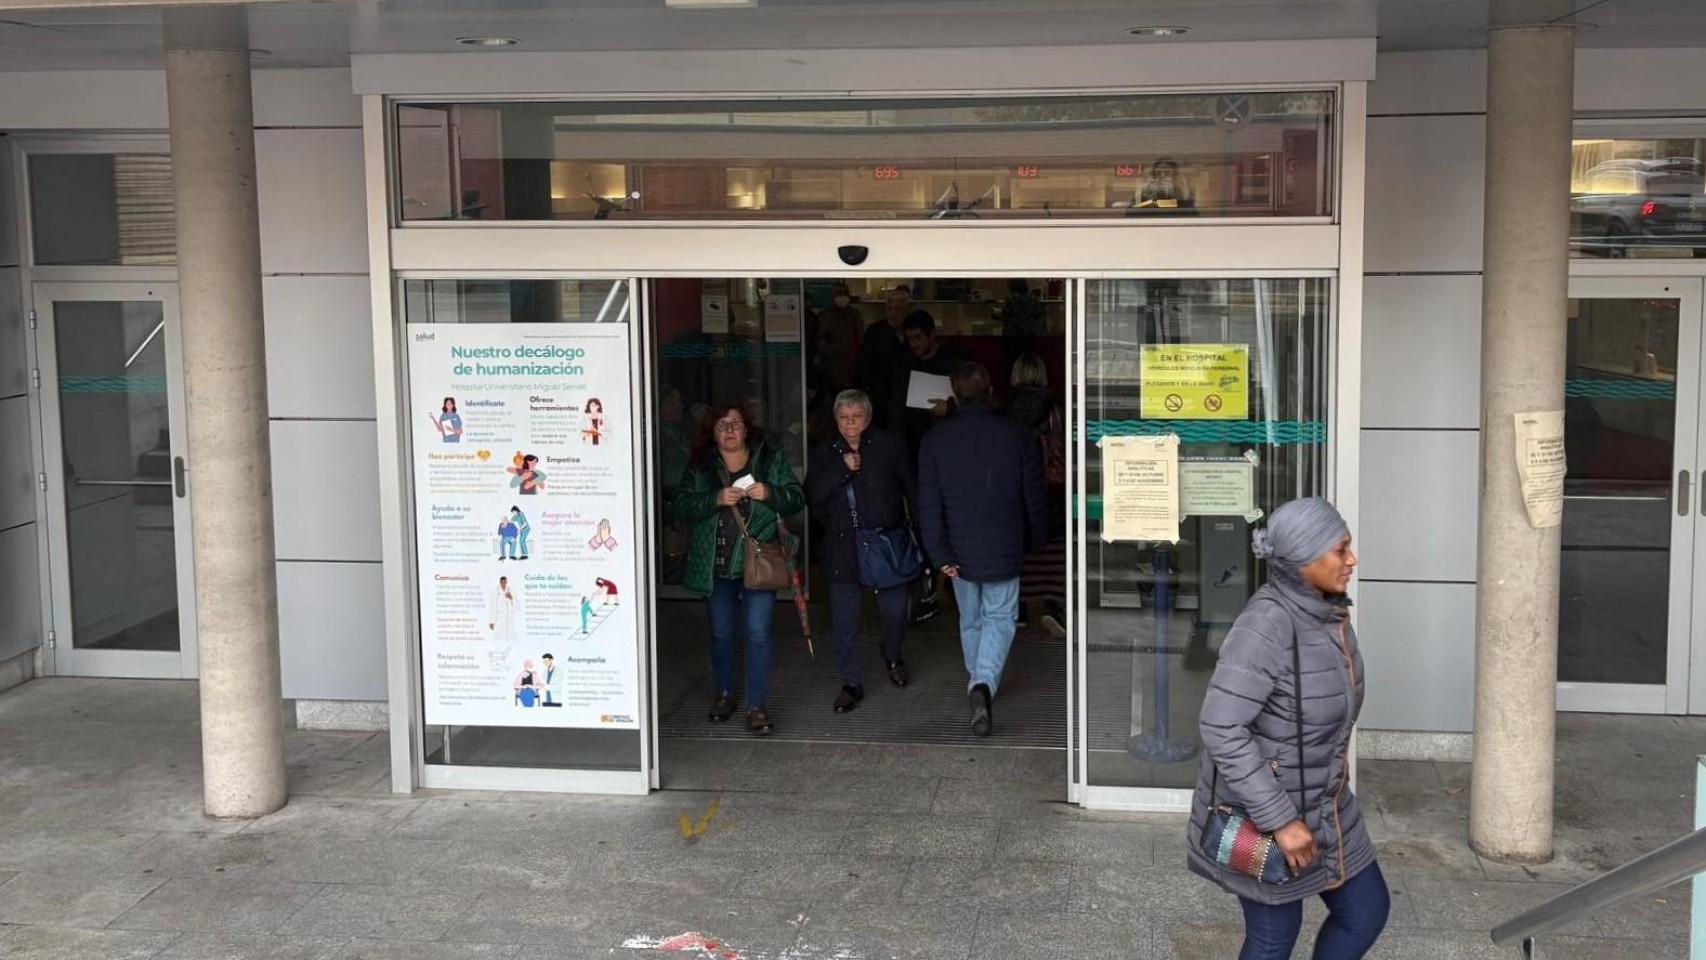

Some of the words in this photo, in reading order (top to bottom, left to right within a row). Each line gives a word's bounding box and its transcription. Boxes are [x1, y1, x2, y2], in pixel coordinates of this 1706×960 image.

[875, 167, 899, 178] 695
[451, 345, 510, 358] Nuestro
[514, 345, 585, 361] decálogo
[453, 362, 472, 375] de
[476, 362, 584, 375] humanización
[451, 383, 483, 392] Hospital
[484, 383, 532, 391] Universitario
[533, 383, 558, 393] Miguel
[529, 395, 554, 403] Ofrece
[529, 404, 579, 412] herramientas
[431, 504, 455, 512] Ayuda
[541, 511, 572, 519] Asegura
[568, 656, 606, 664] Acompaña
